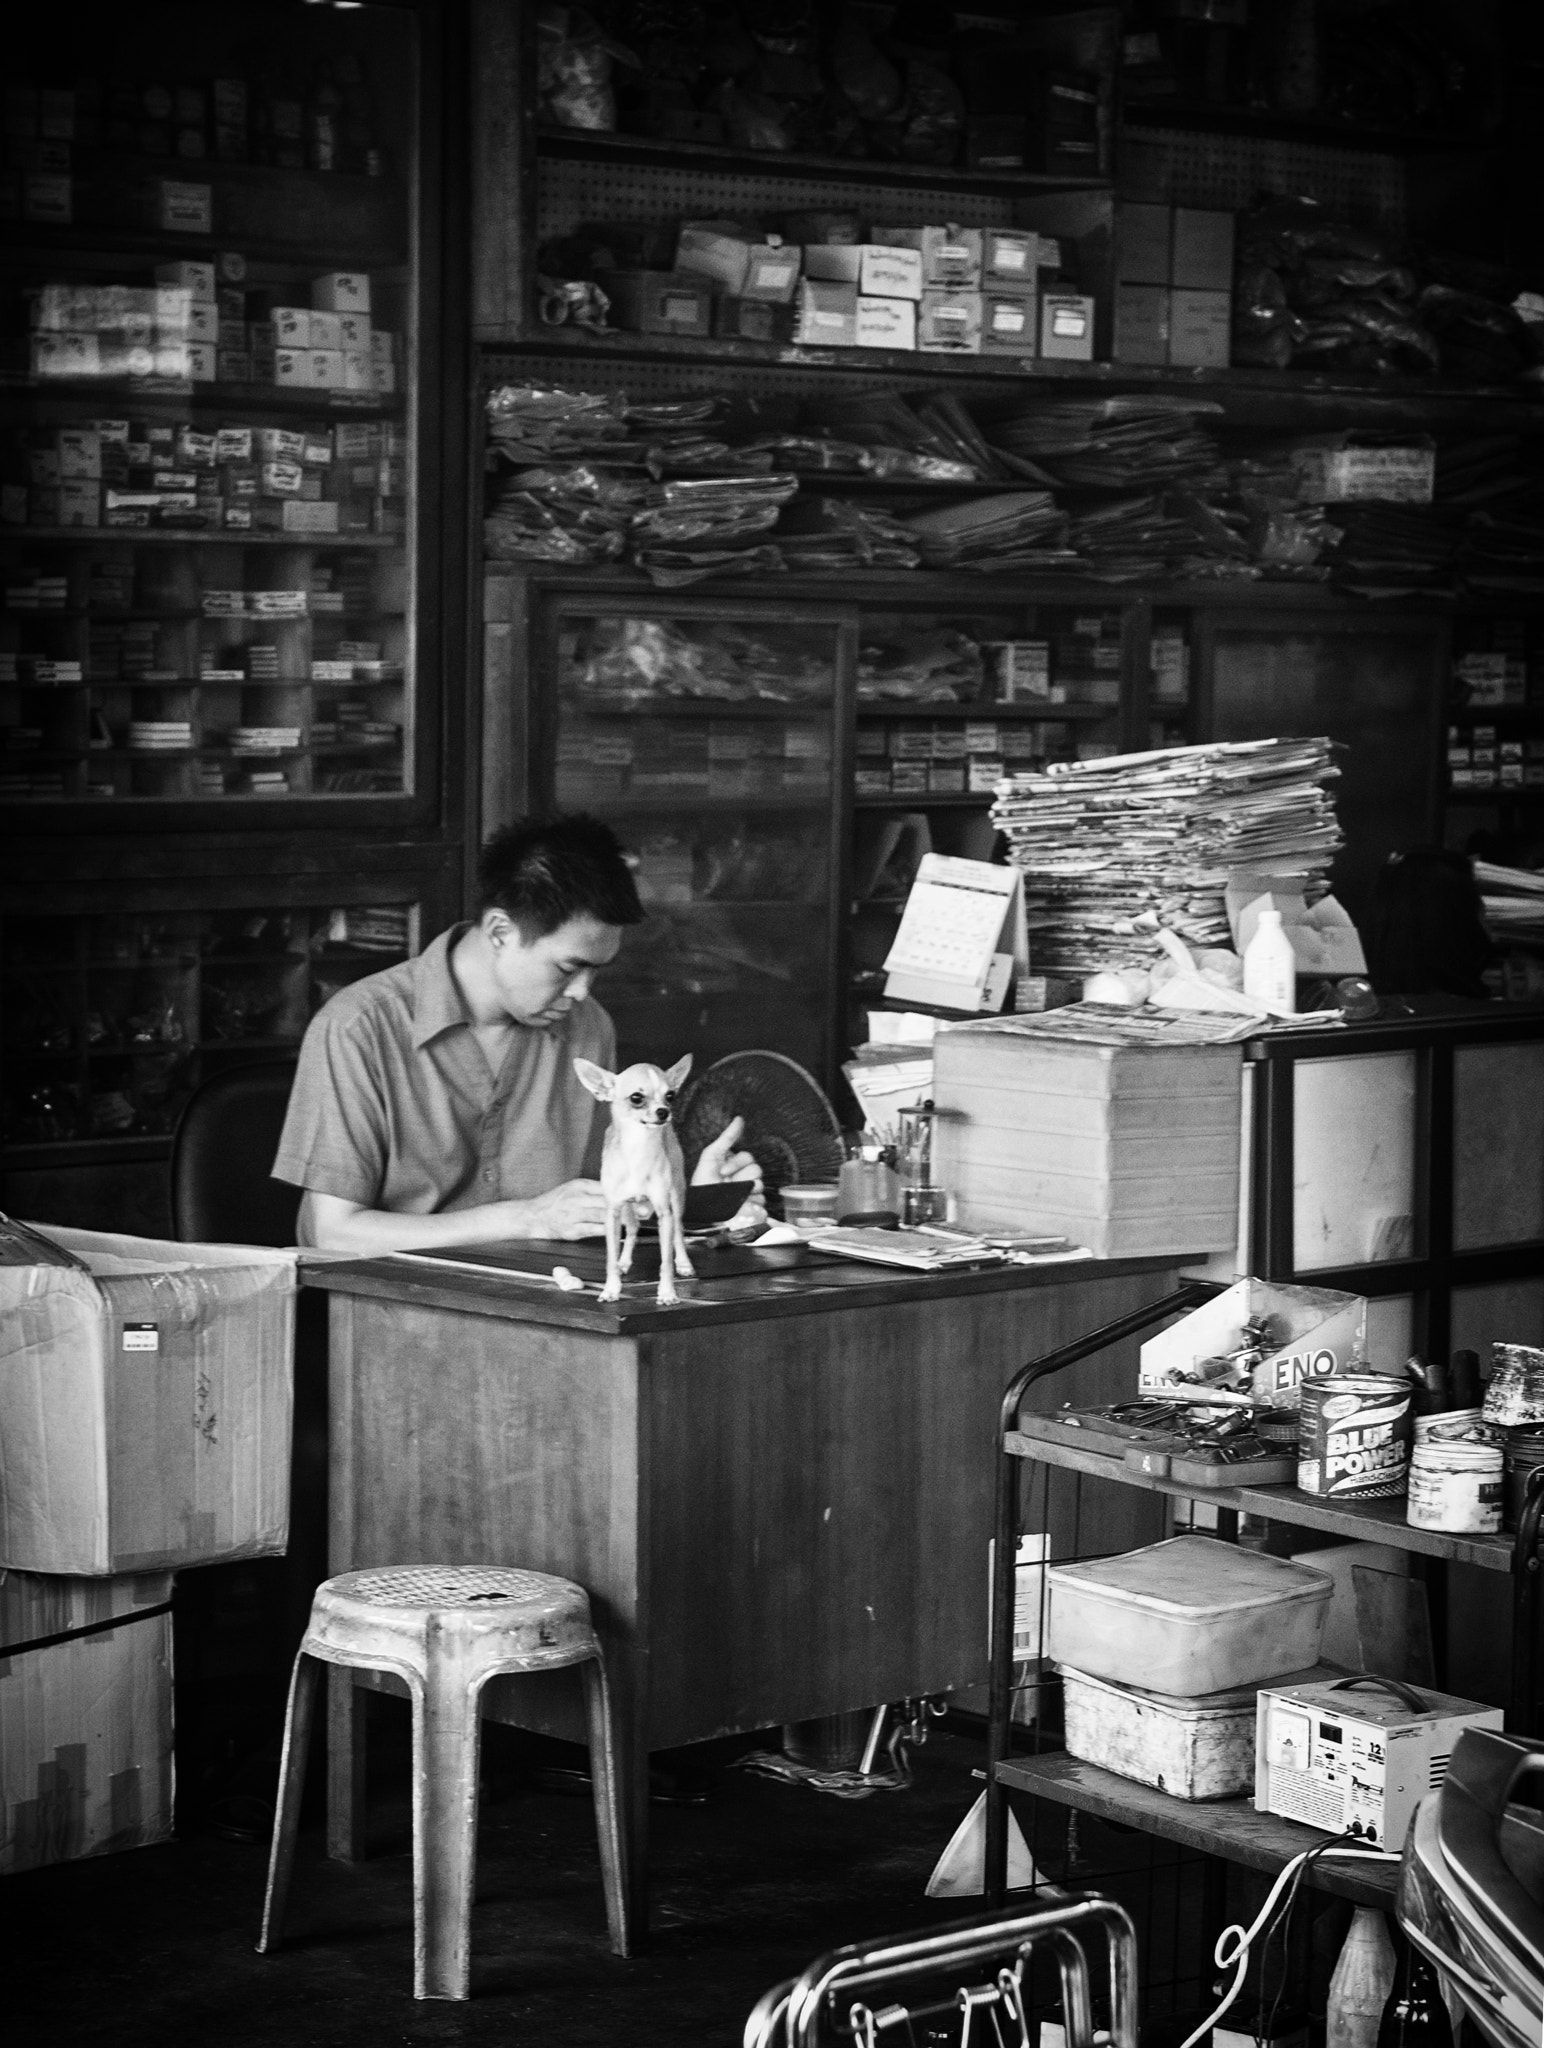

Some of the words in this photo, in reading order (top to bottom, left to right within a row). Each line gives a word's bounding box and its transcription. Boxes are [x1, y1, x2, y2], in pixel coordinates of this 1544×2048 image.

[1274, 1350, 1336, 1391] ENO
[1326, 1423, 1393, 1456] BLUE
[1326, 1440, 1405, 1478] POWER
